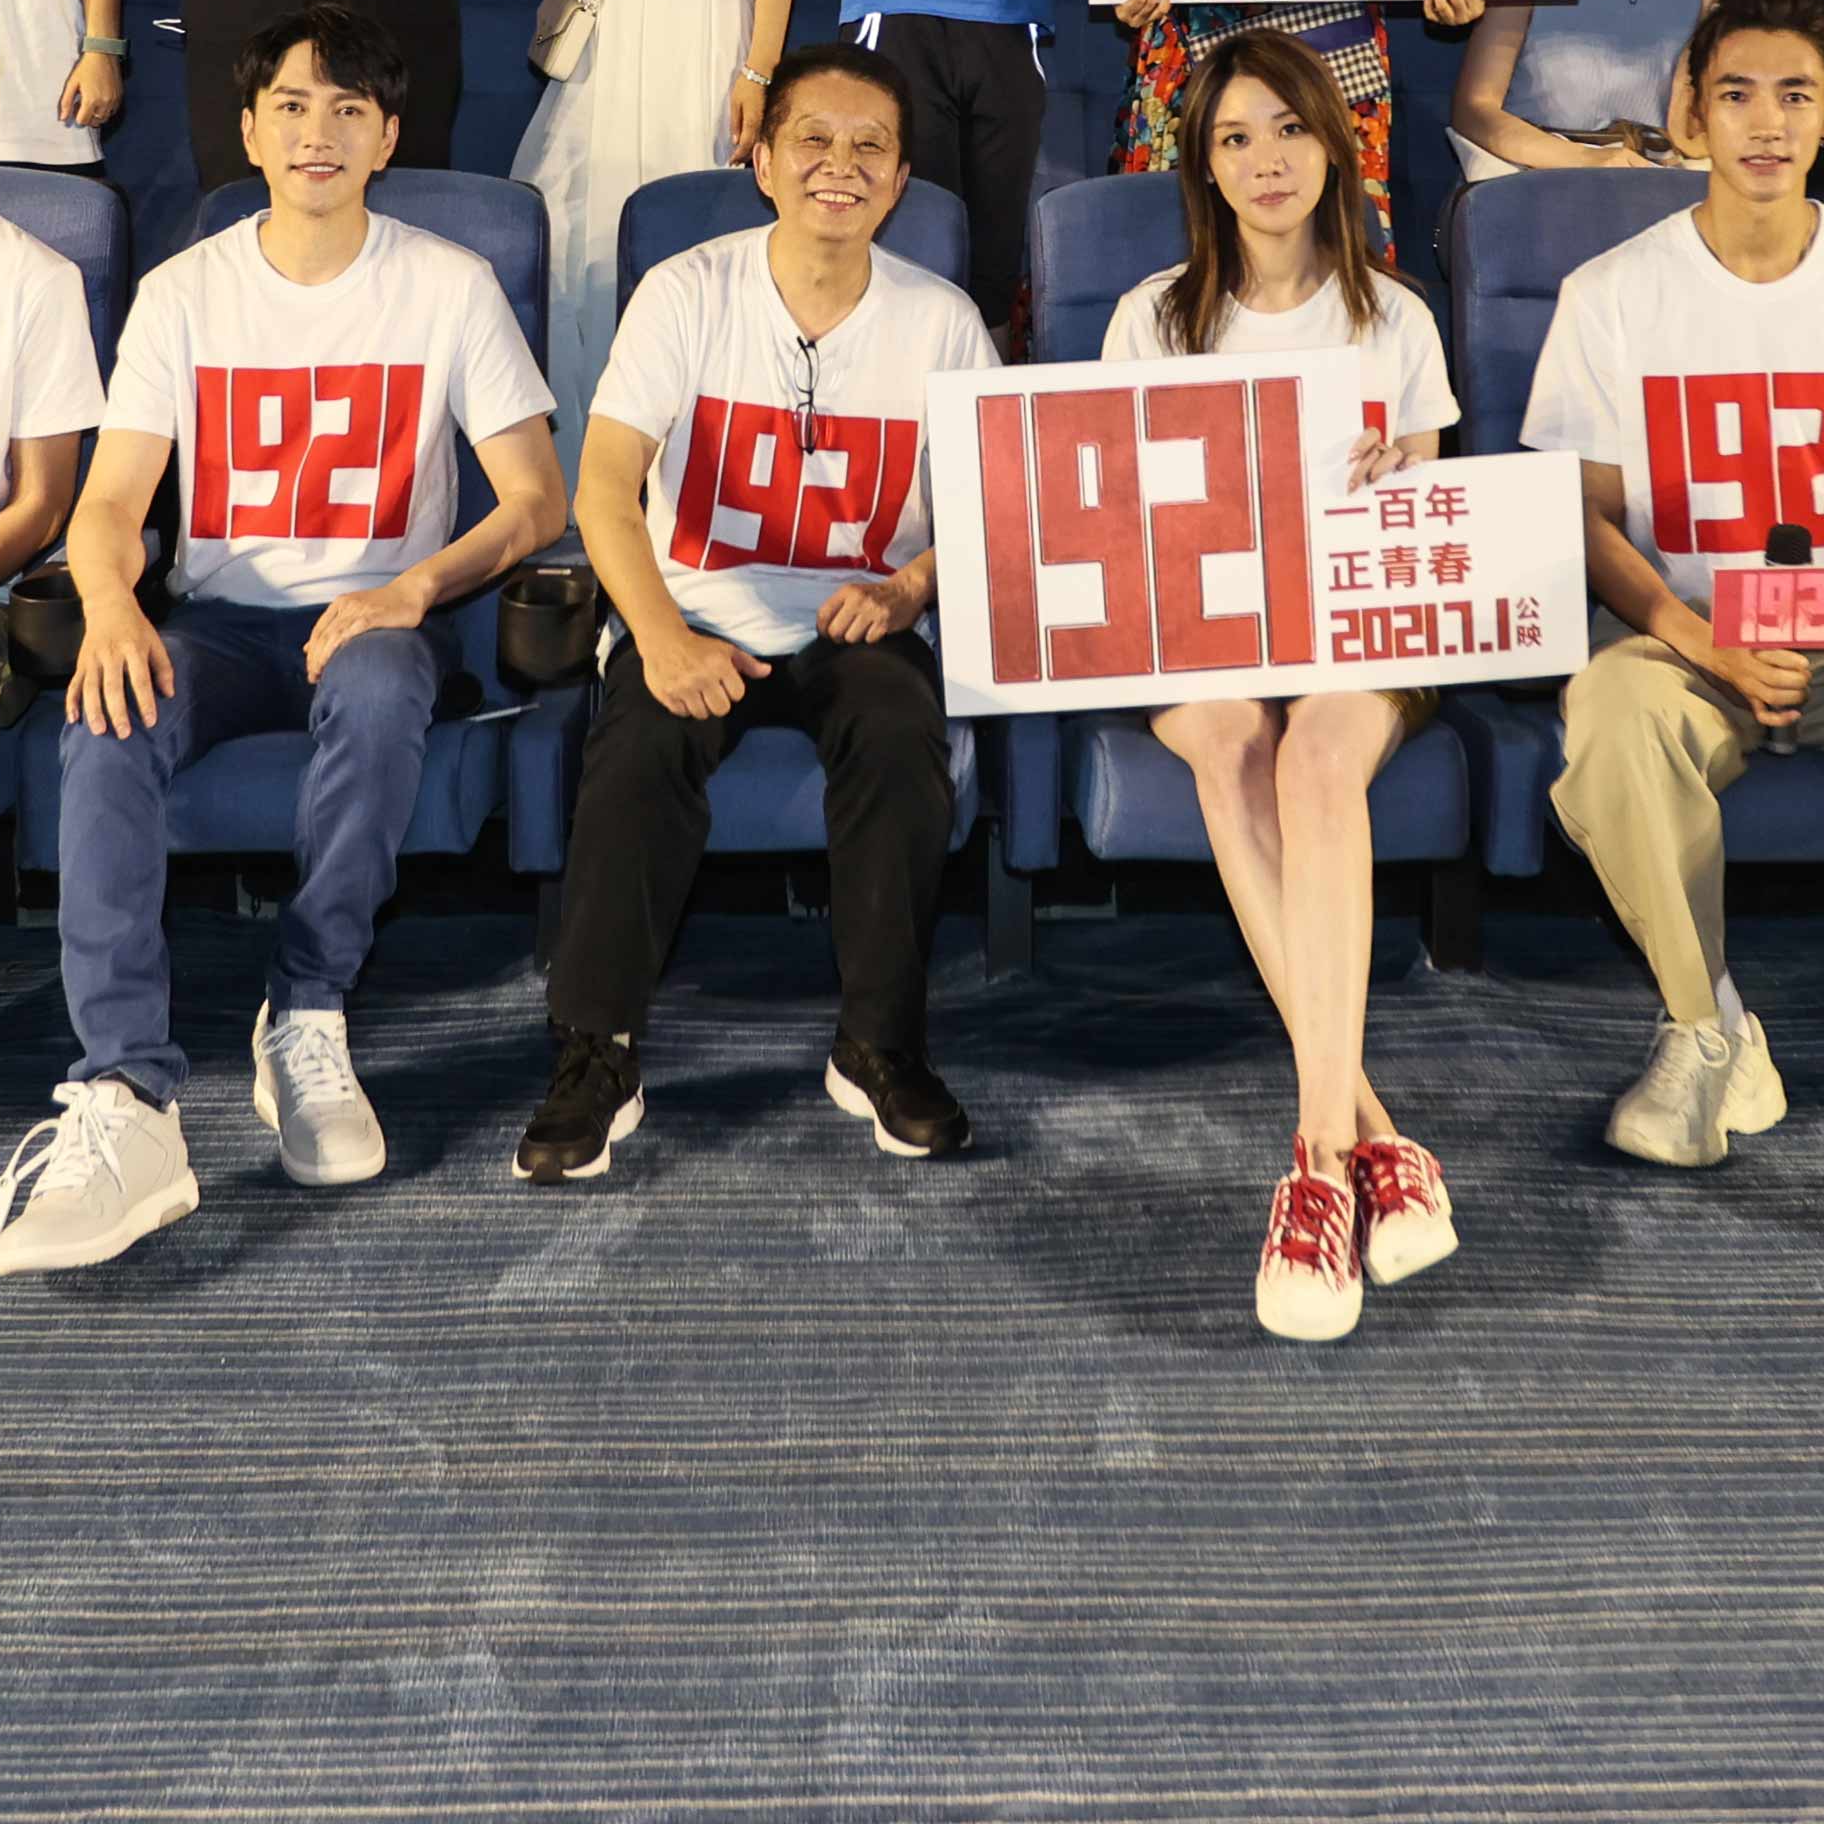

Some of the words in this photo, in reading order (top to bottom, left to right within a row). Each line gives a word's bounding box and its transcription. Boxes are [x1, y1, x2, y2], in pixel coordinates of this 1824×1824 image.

[190, 363, 425, 539] 1921
[669, 394, 918, 576] 1921
[1324, 483, 1470, 531] 一百年
[977, 376, 1316, 684] 1921
[1328, 542, 1472, 591] 正青春
[1331, 597, 1511, 662] 2021.7.1
